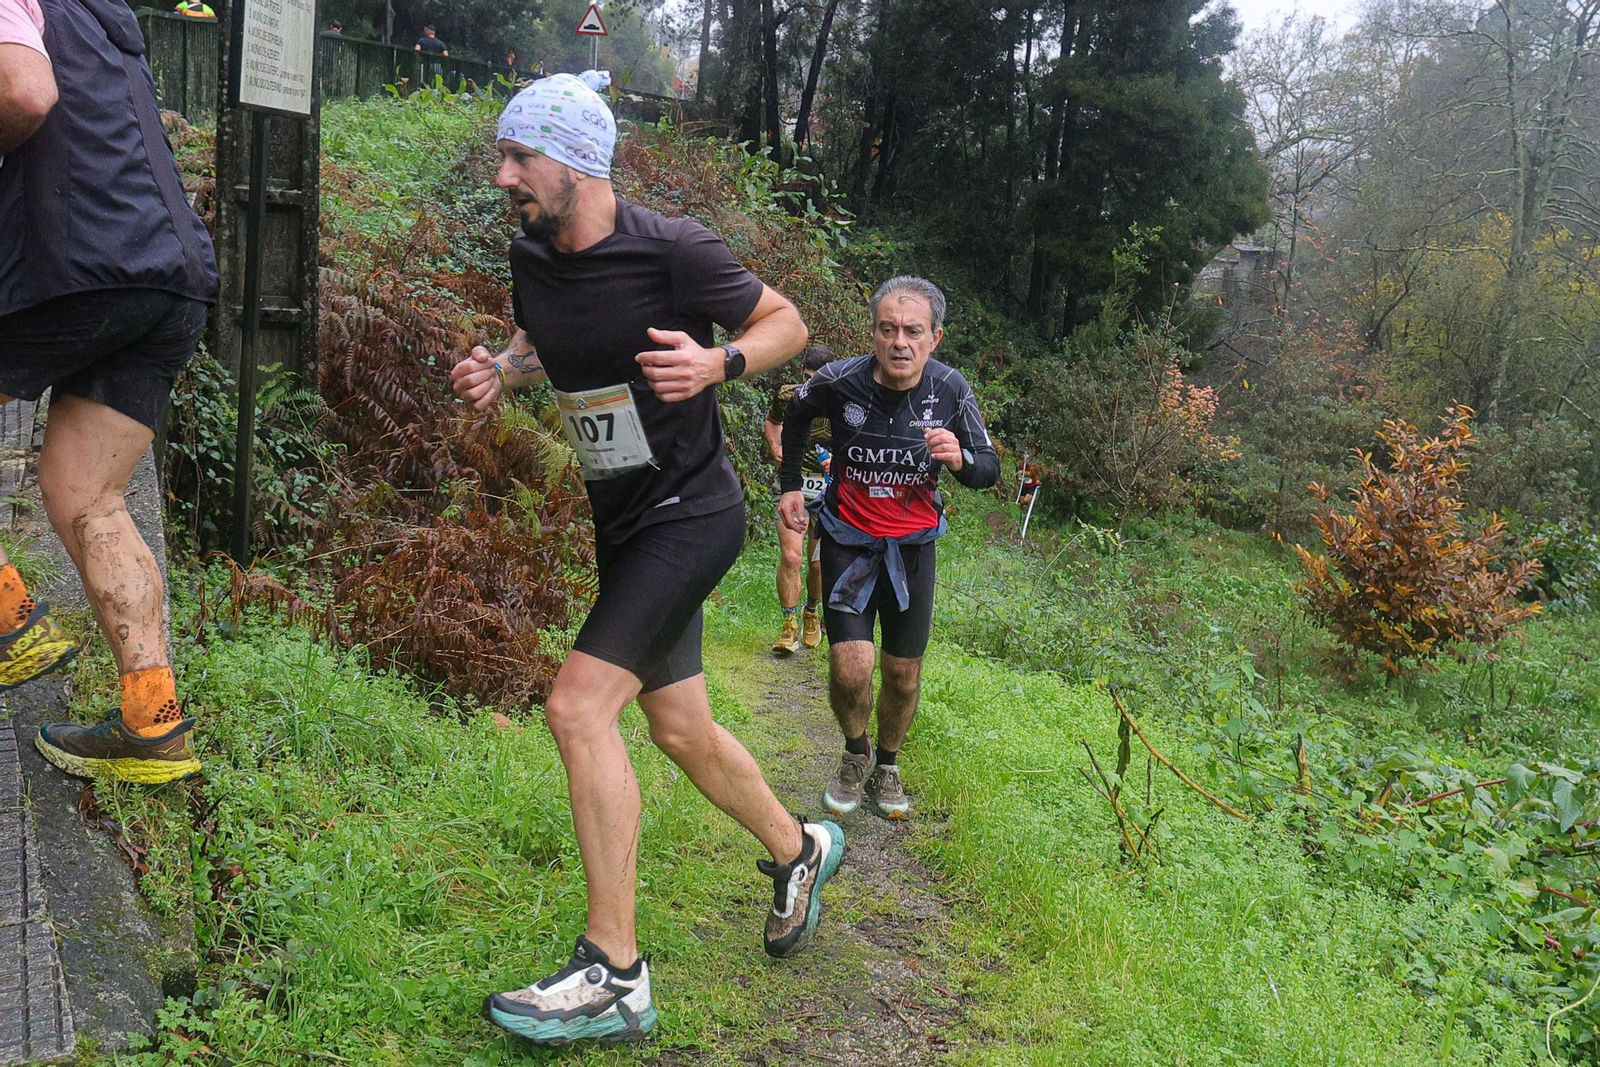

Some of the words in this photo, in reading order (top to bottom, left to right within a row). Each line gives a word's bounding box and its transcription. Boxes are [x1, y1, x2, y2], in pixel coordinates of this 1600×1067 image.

[568, 413, 614, 443] 107
[909, 420, 944, 428] CHUVONERS
[847, 446, 916, 467] GMTA
[917, 461, 930, 473] &
[845, 466, 929, 486] CHUVONERS
[6, 624, 47, 660] HOKA
